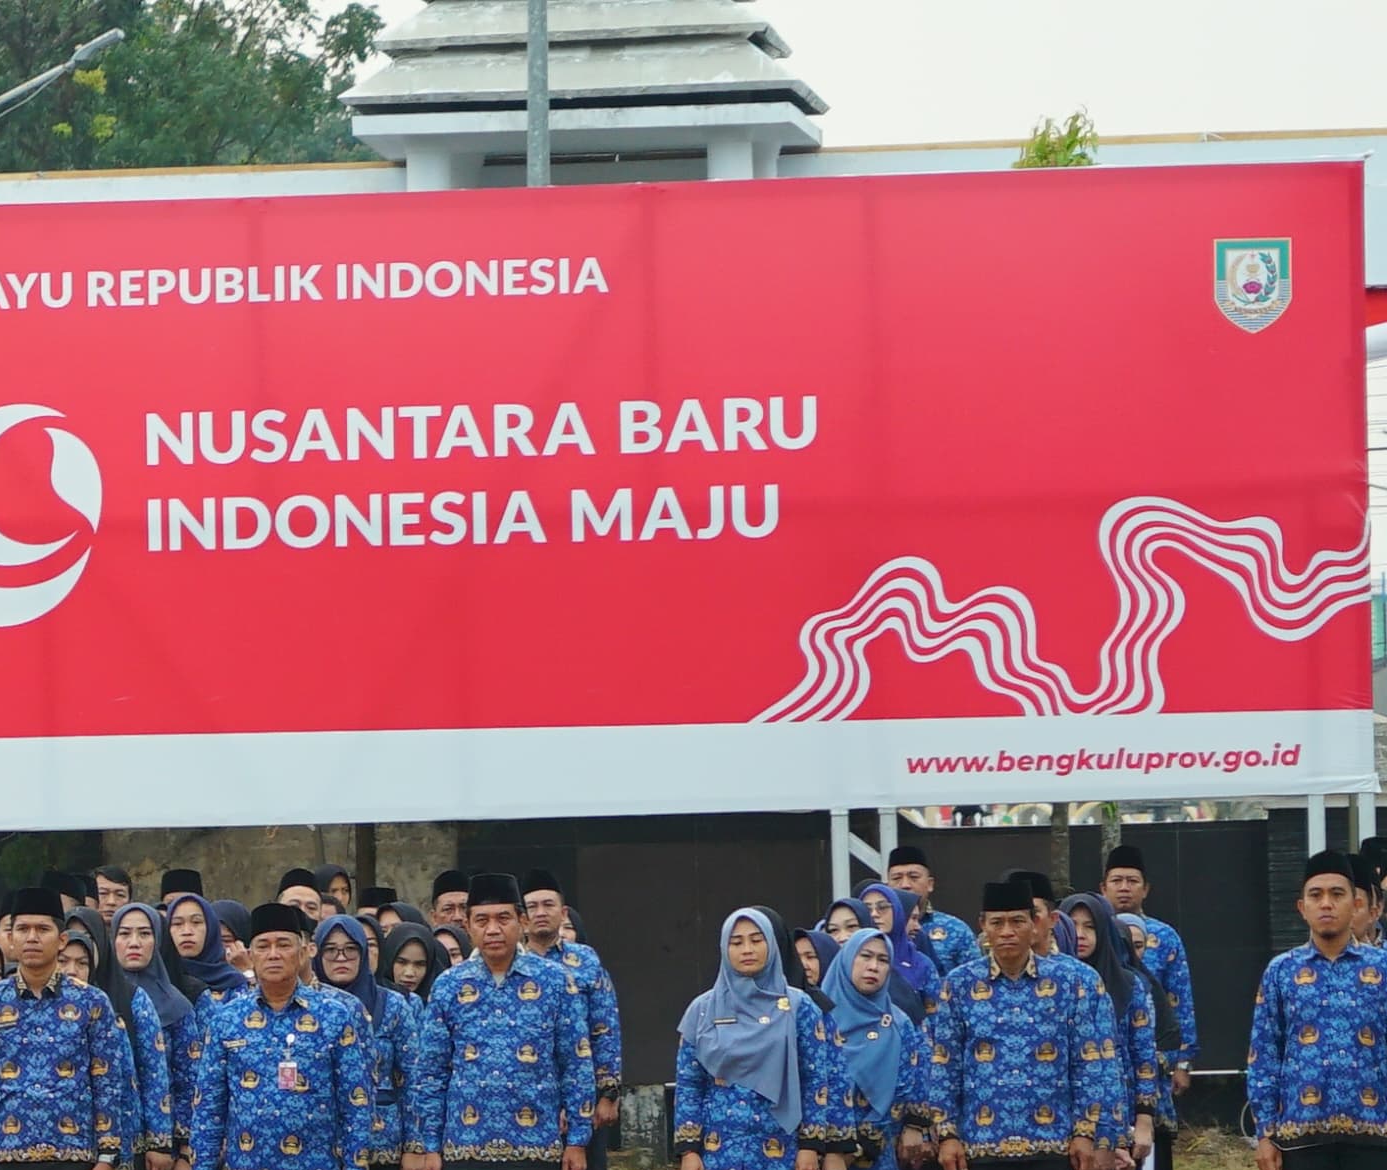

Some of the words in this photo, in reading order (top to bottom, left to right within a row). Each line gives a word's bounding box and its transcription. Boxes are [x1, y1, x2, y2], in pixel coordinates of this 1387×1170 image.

[87, 264, 323, 307] REPUBLIK
[336, 256, 609, 300] INDONESIA
[145, 402, 596, 466] NUSANTARA
[619, 395, 818, 454] BARU
[147, 490, 547, 553] INDONESIA
[571, 484, 780, 542] MAJU
[906, 743, 1302, 777] www.bengkuluprov.go.id
